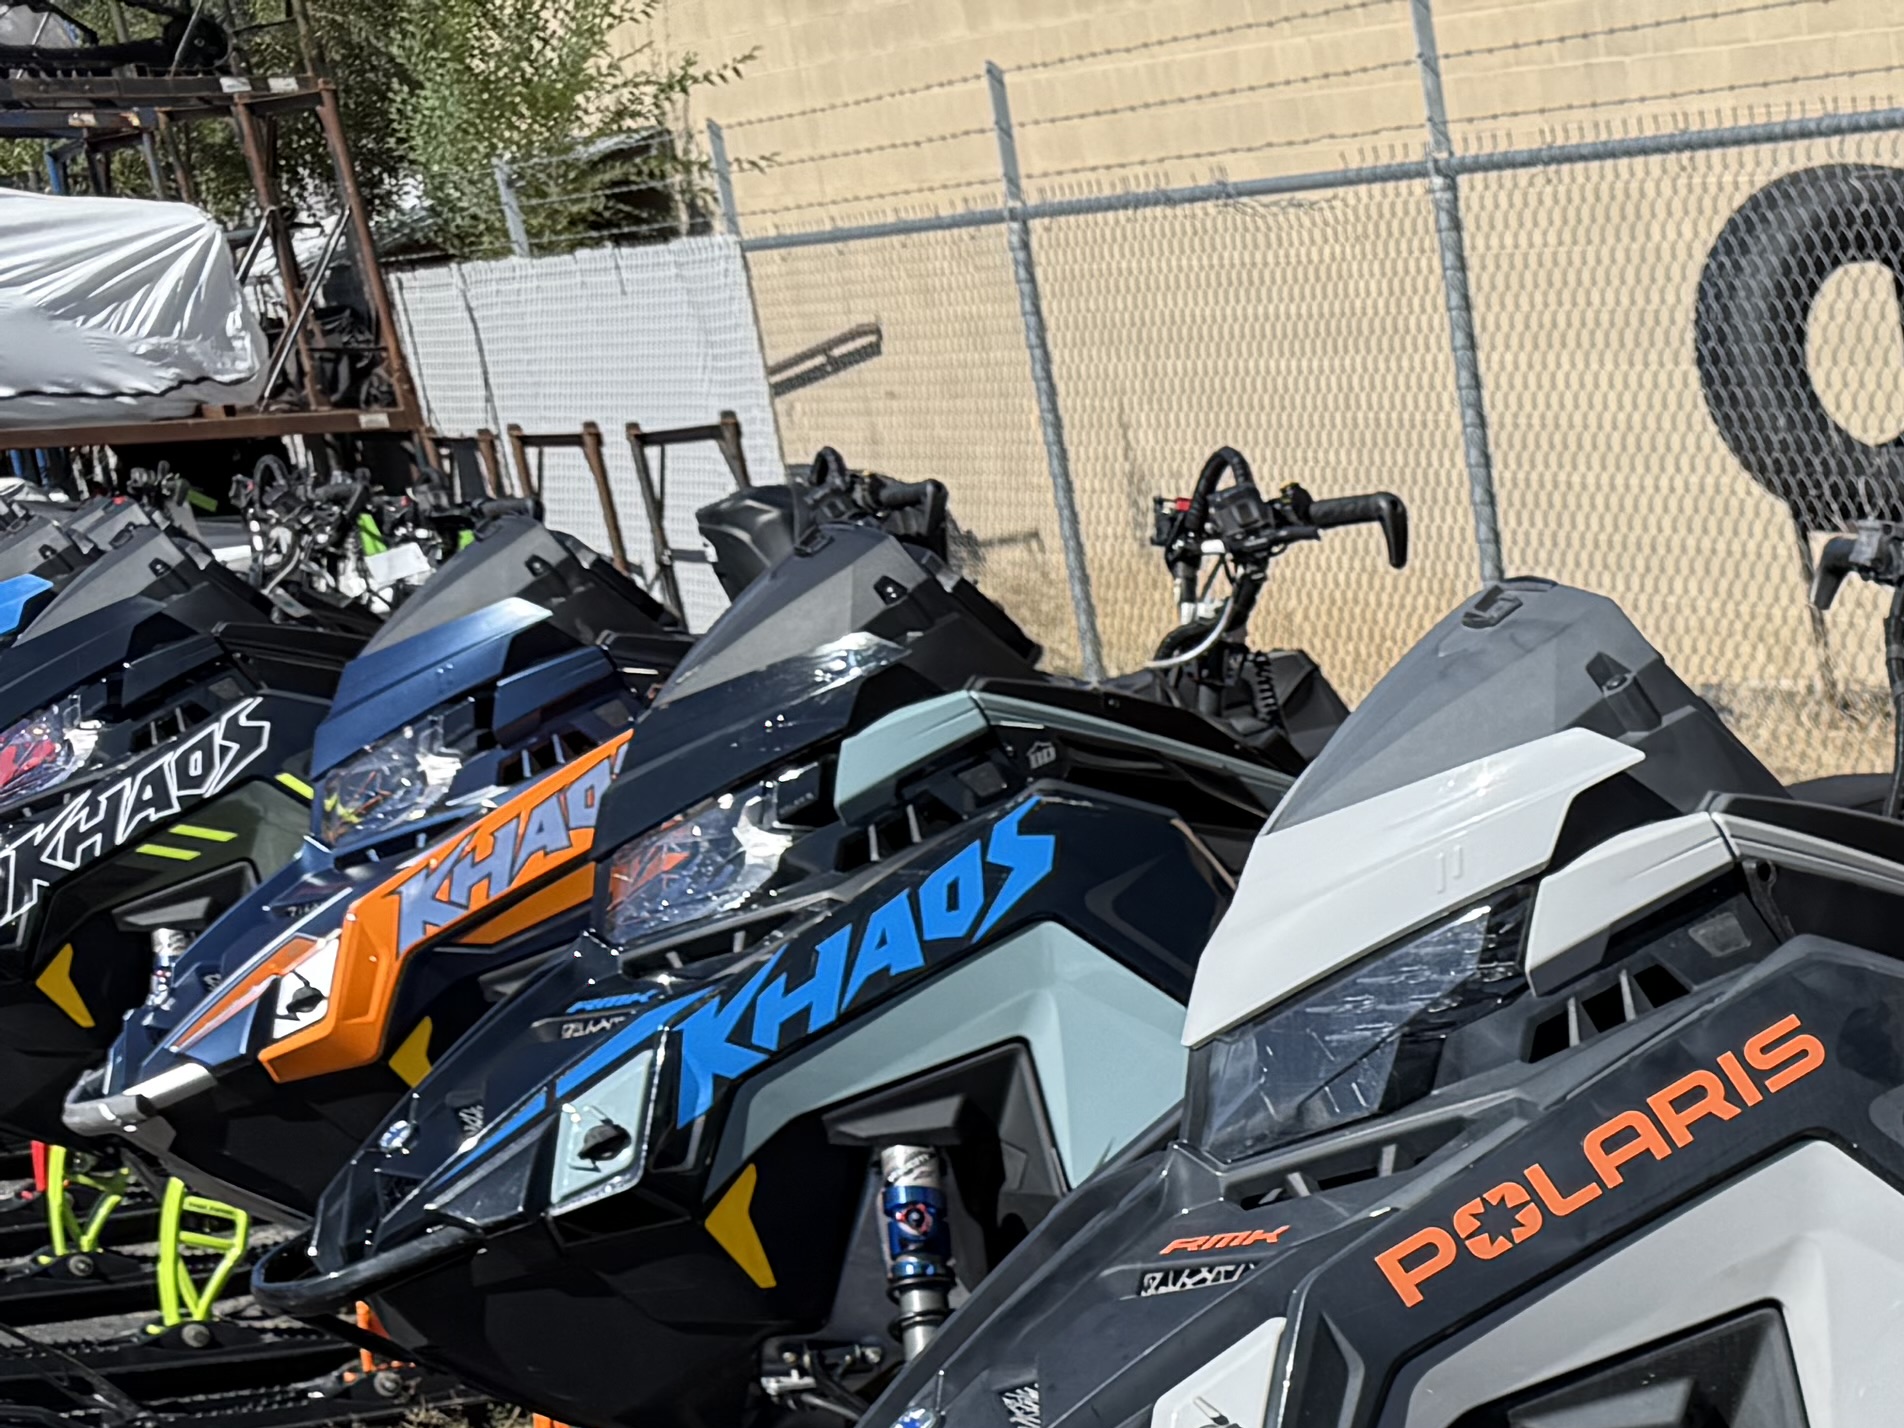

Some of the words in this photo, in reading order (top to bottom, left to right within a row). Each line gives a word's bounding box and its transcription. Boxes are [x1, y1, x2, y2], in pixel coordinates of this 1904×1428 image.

[0, 696, 271, 927] KHAOS
[673, 795, 1056, 1130] KHAOS
[1159, 1224, 1291, 1255] RMK
[1374, 1013, 1826, 1308] POLARIS
